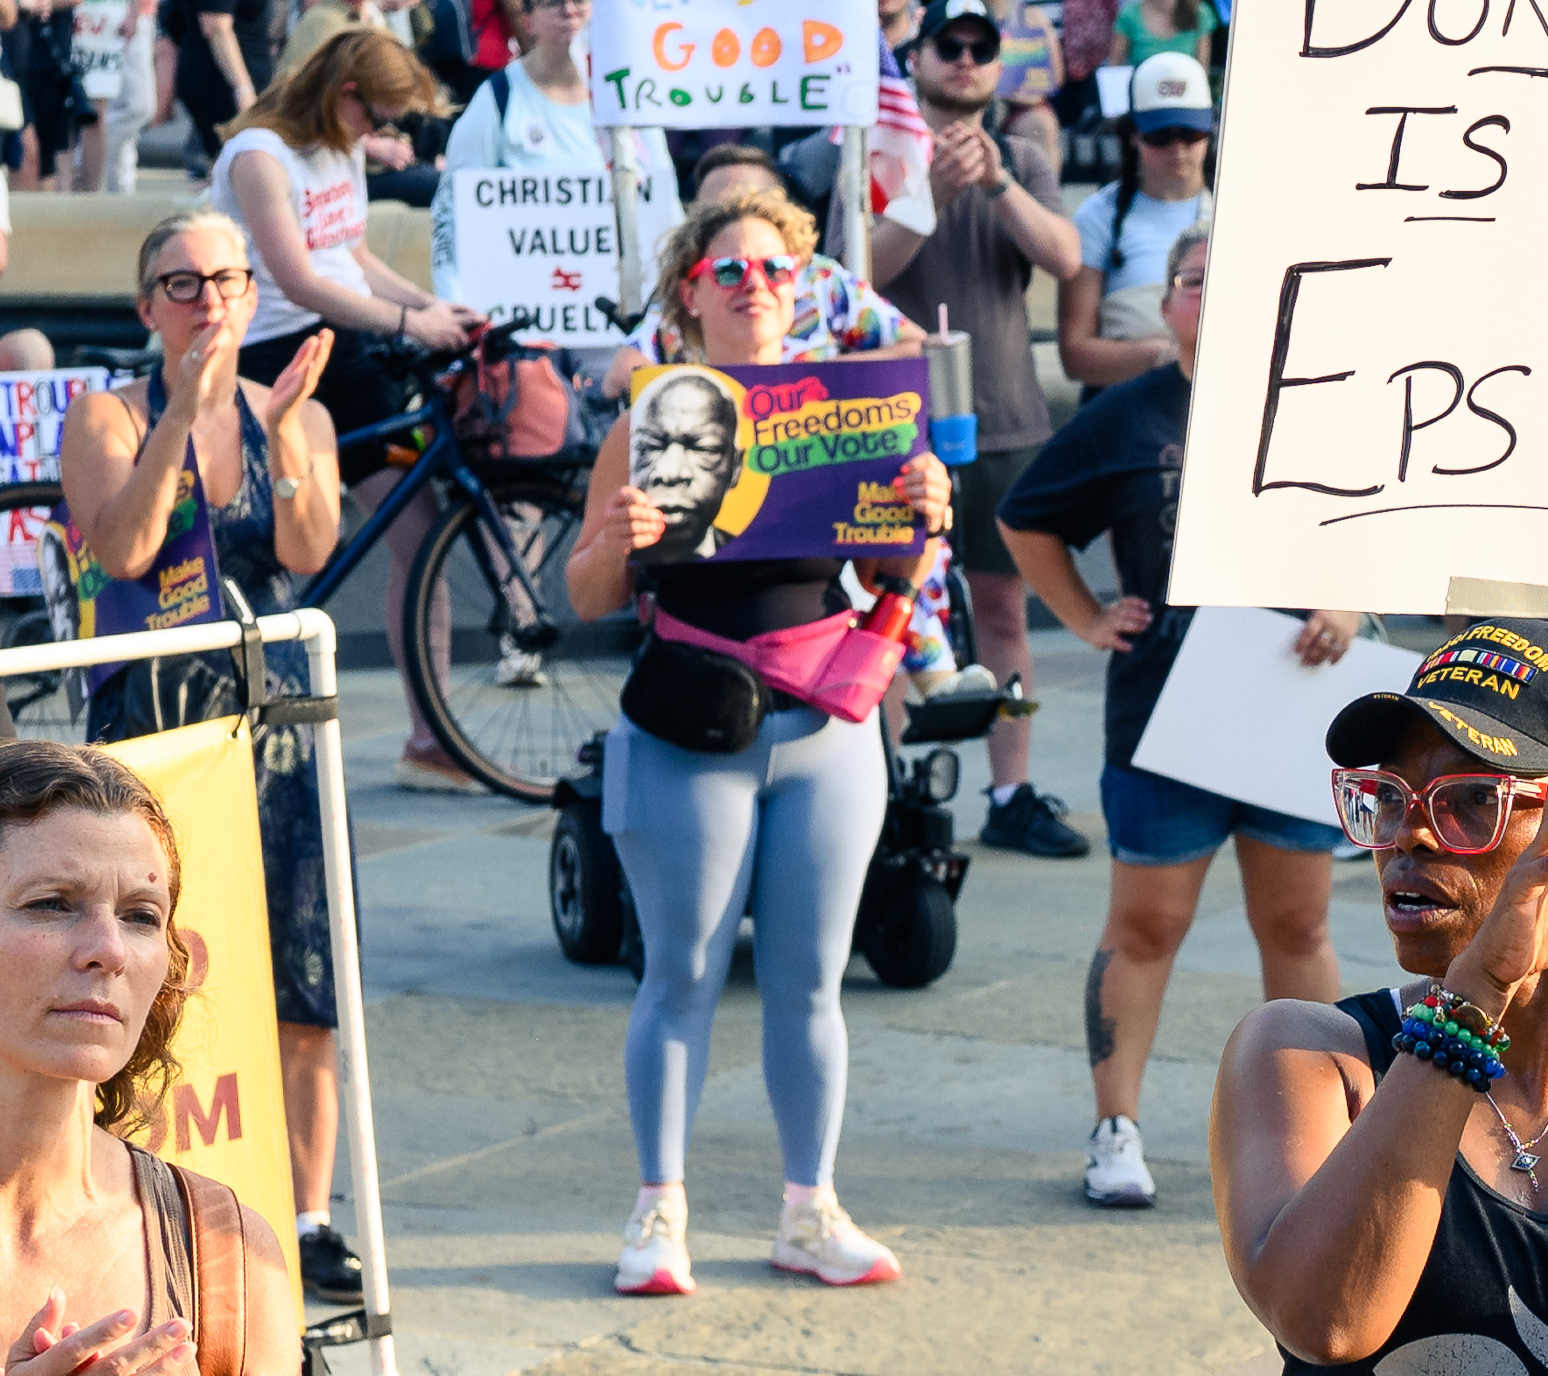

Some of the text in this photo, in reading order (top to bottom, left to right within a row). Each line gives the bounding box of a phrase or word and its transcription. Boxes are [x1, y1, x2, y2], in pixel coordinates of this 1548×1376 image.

[652, 21, 844, 73] GOOD
[1355, 105, 1511, 201] IS
[475, 176, 654, 208] CHRISTIN
[488, 304, 614, 333] CRUEL
[751, 387, 806, 417] Our
[753, 397, 912, 445] Freedoms
[756, 429, 899, 473] Our Vote
[832, 522, 915, 544] Trouble
[1417, 666, 1521, 701] VETERAN
[1427, 700, 1519, 757] VETERAN
